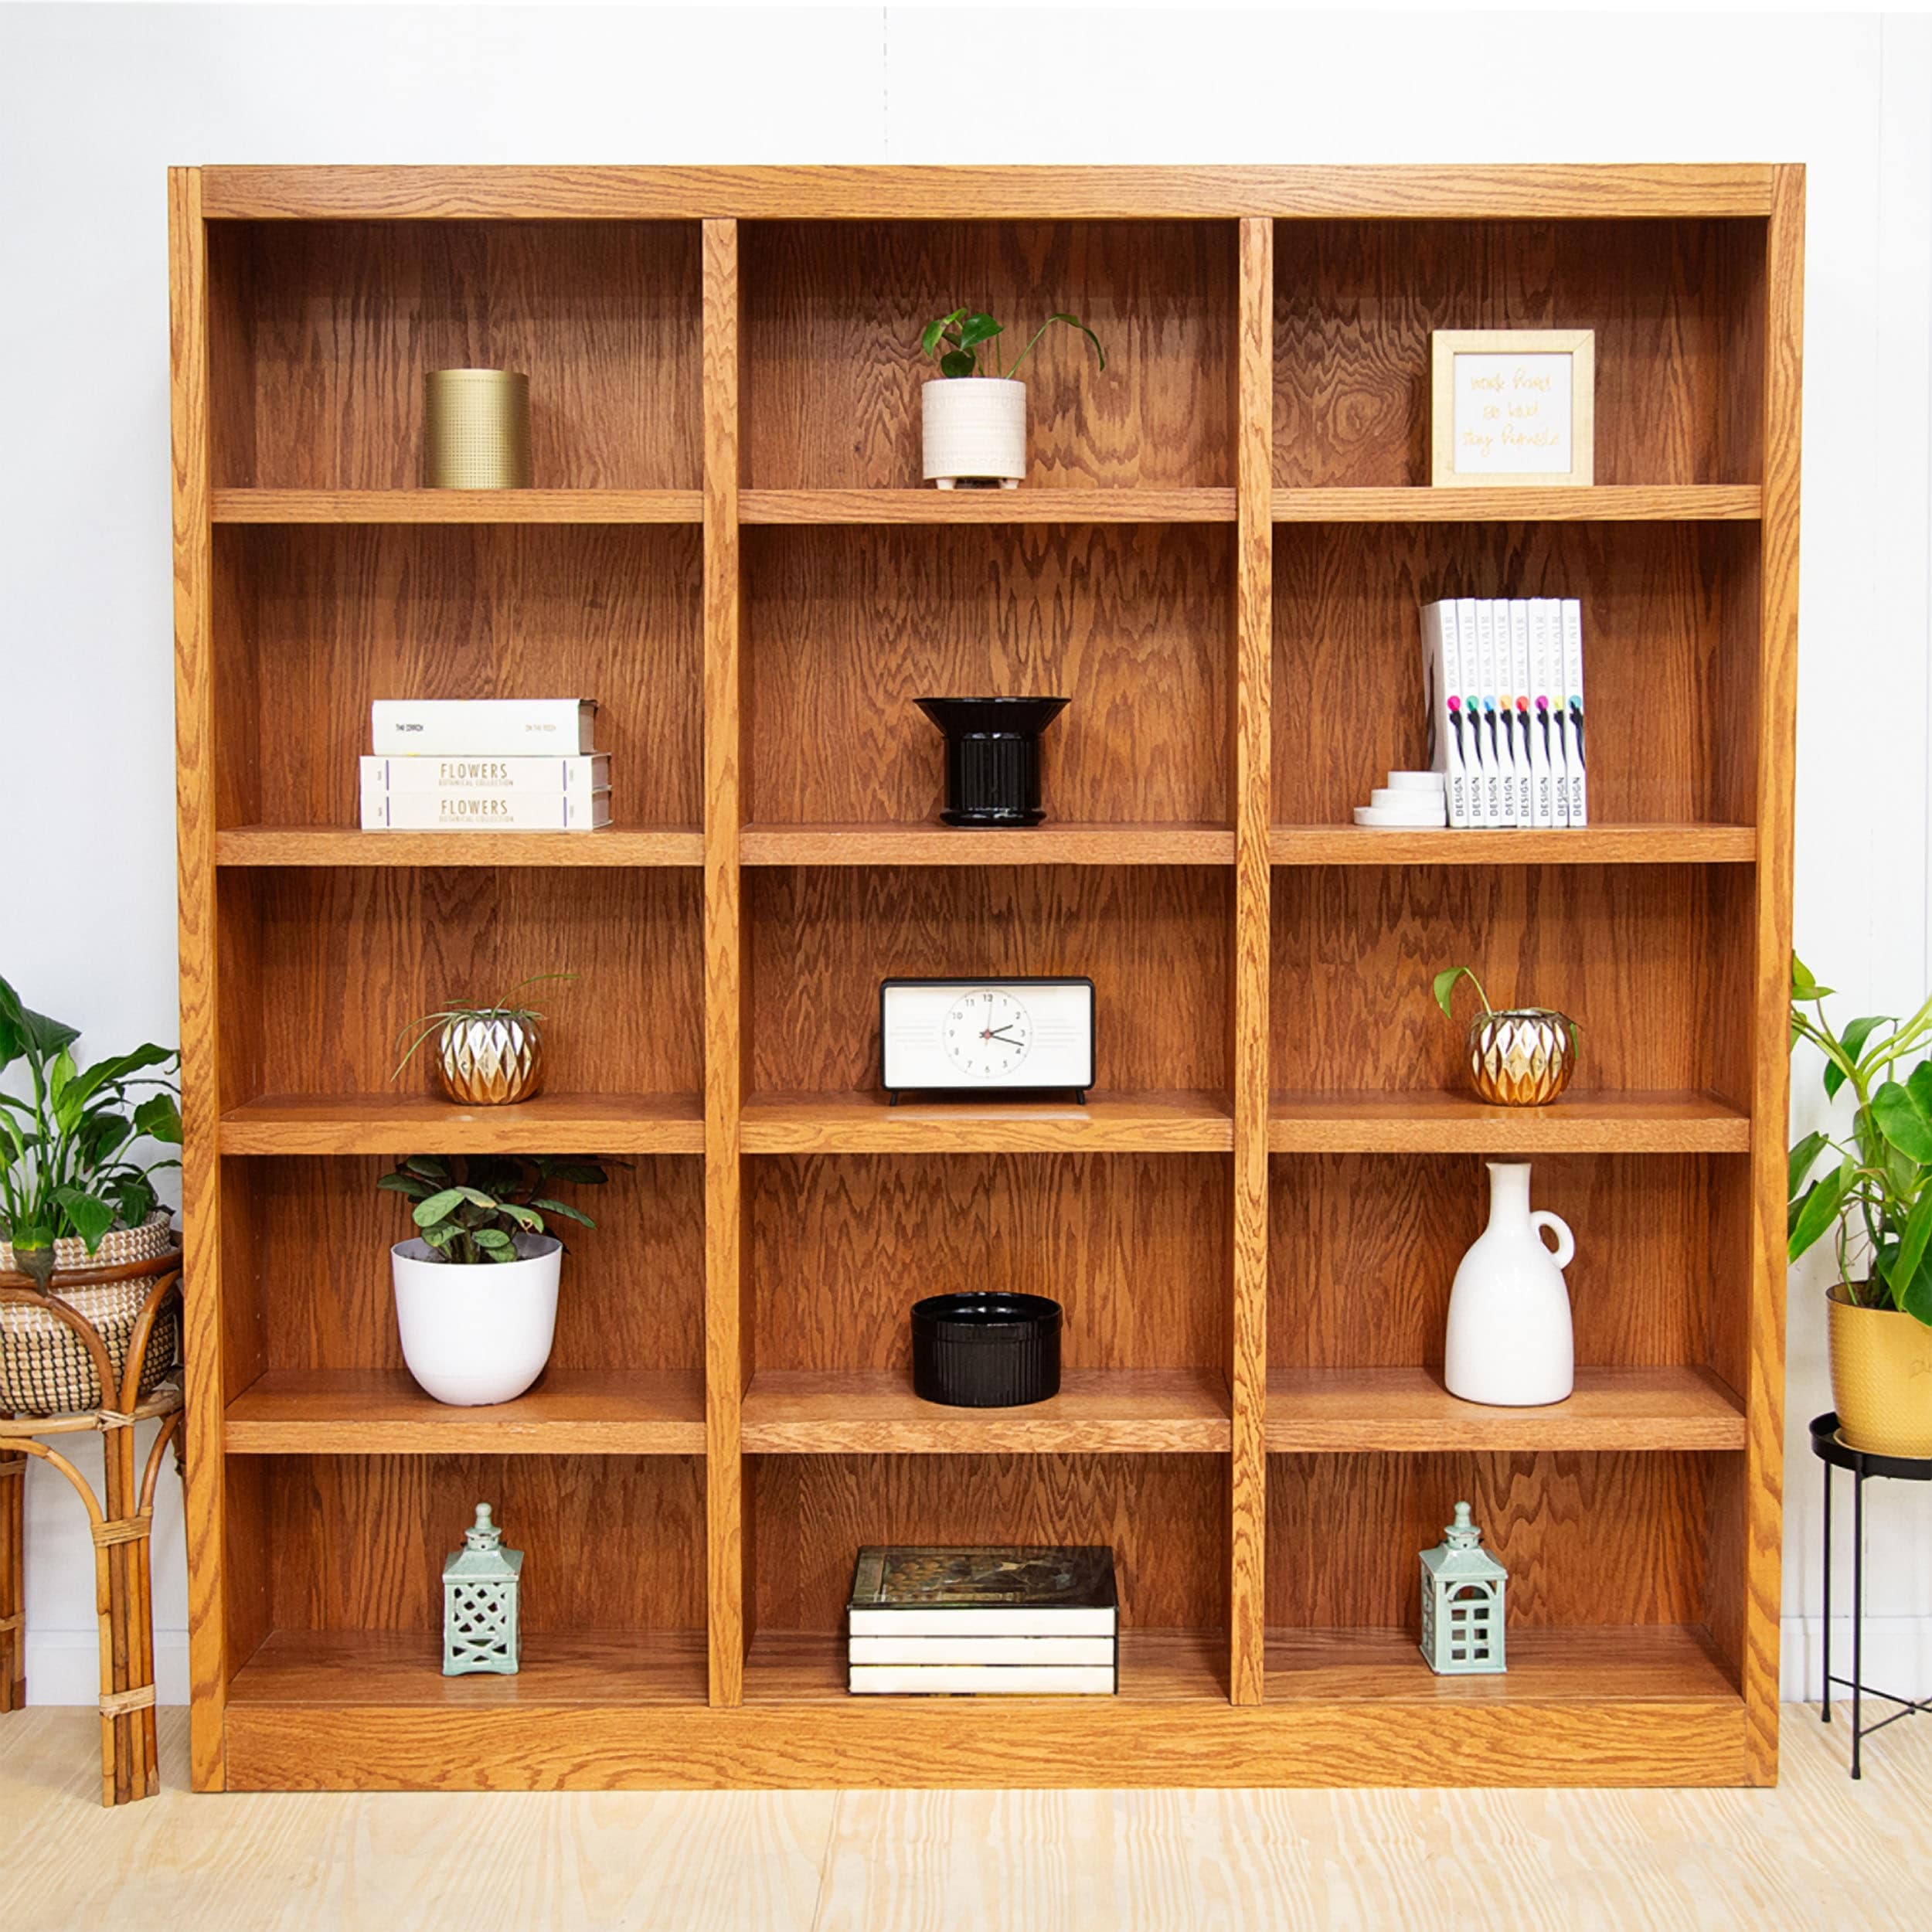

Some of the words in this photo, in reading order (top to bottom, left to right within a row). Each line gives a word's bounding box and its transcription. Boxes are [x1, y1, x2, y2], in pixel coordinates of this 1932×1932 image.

[440, 764, 508, 779] FLOWERS
[440, 800, 508, 815] FLOWERS
[1454, 777, 1464, 817] DESIGN
[1471, 777, 1481, 817] DESIGN
[1488, 777, 1498, 817] DESIGN
[1504, 777, 1514, 817] DESIGN
[1520, 777, 1529, 817] DESIGN
[1540, 777, 1549, 817] DESIGN
[1557, 777, 1566, 817] DESIGN
[1573, 777, 1582, 817] DESIGN
[953, 1012, 963, 1020] 10
[984, 994, 993, 1002] 12
[1015, 1012, 1020, 1020] 2
[954, 1047, 959, 1056] 8
[1003, 1060, 1008, 1069] 5
